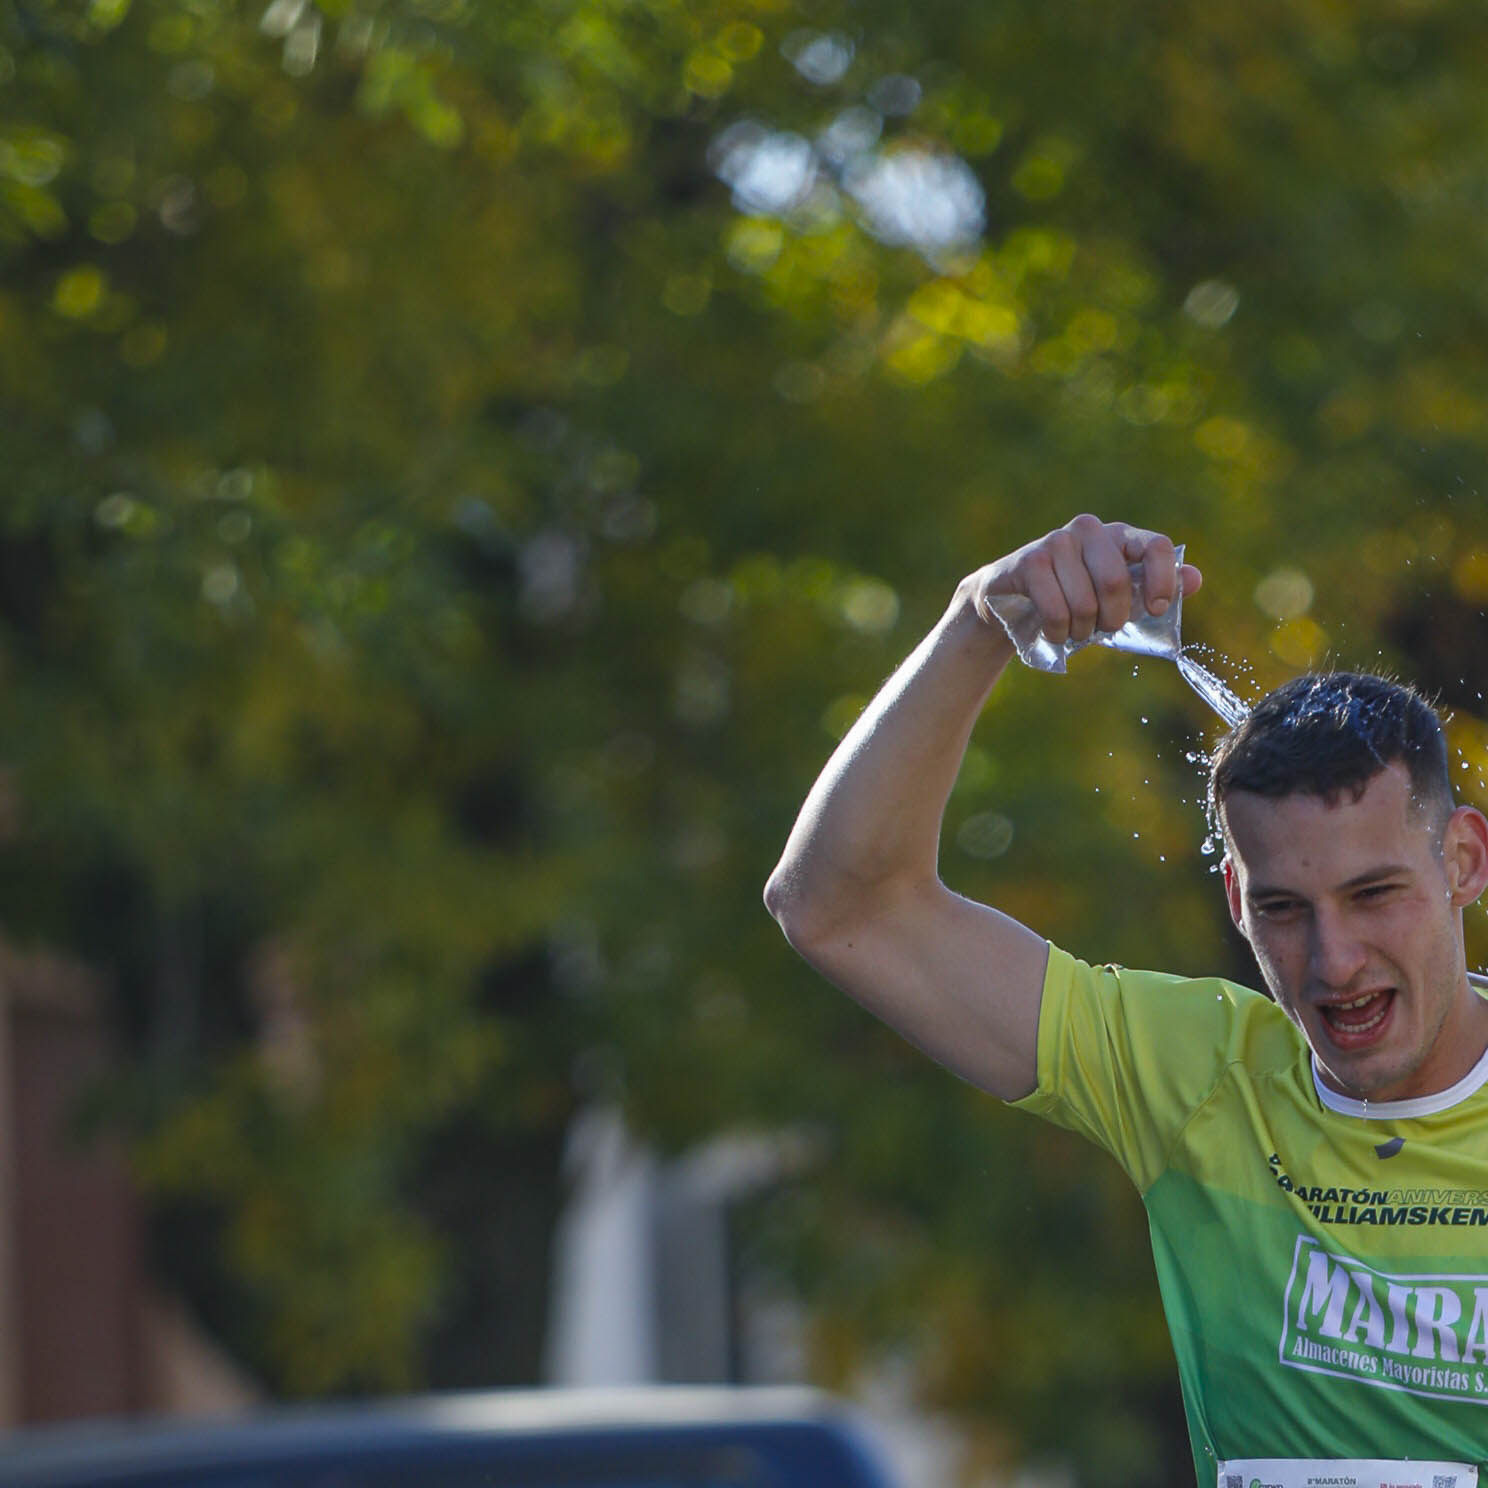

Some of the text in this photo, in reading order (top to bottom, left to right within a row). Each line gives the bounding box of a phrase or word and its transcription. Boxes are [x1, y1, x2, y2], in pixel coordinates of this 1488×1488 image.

[1294, 1186, 1388, 1205] ARATÓN
[1292, 1335, 1378, 1373] Almacenes
[1382, 1357, 1470, 1391] Mayoristas
